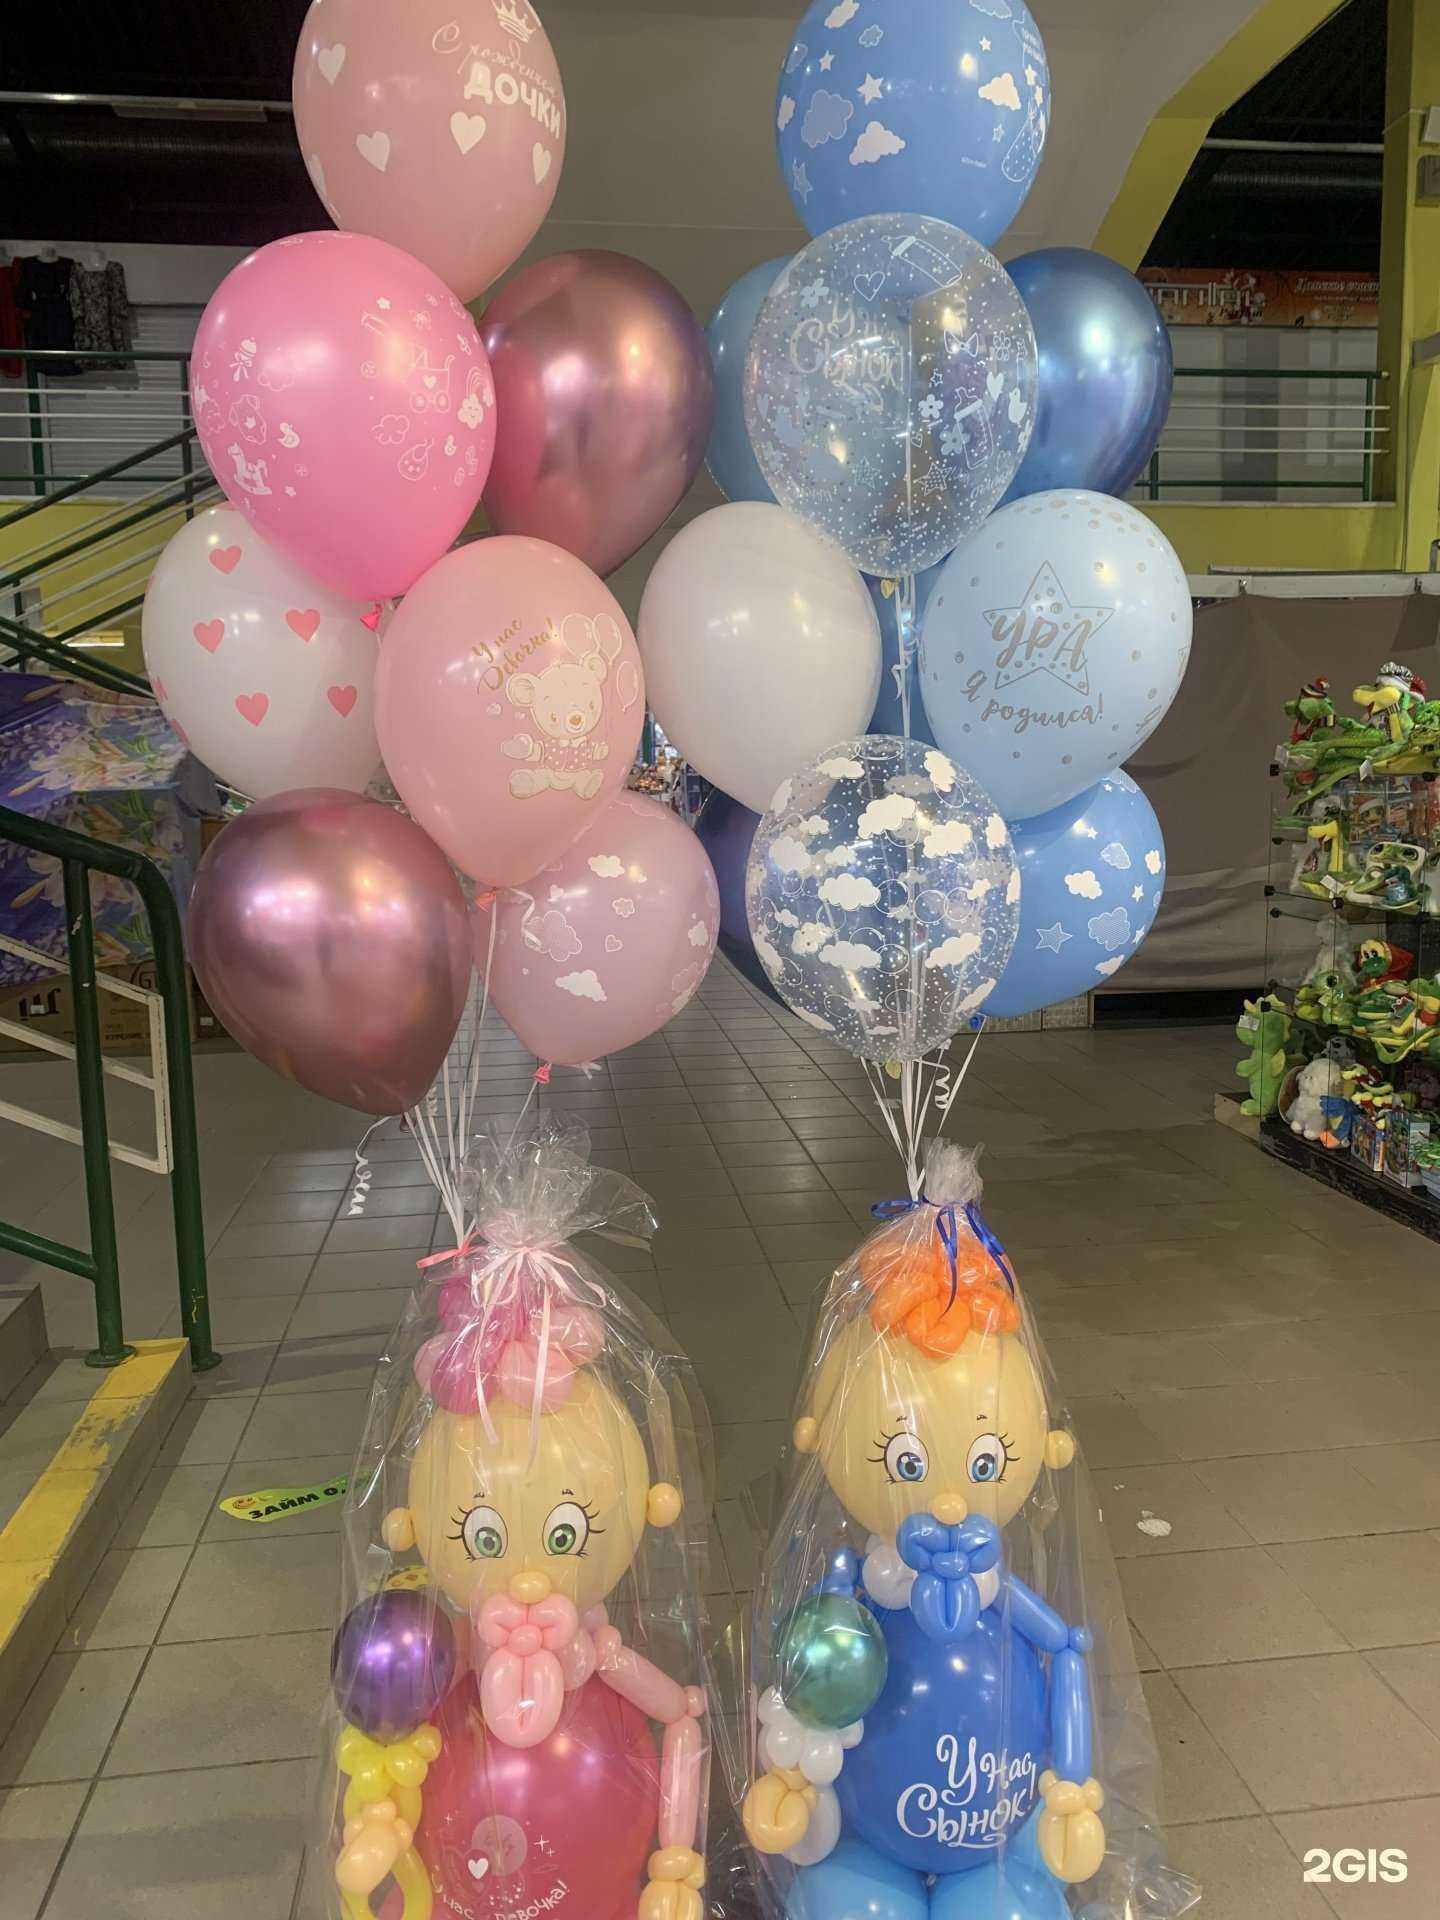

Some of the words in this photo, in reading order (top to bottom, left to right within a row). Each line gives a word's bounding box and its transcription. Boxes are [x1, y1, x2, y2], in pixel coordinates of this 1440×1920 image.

[463, 61, 561, 139] ДОЧКИ
[471, 641, 495, 663] У
[495, 618, 523, 649] нас
[991, 608, 1093, 672] УРА
[960, 670, 988, 702] Я
[981, 692, 1104, 734] родился!
[249, 1492, 320, 1520] ЗАЙМ
[936, 1734, 977, 1806] У
